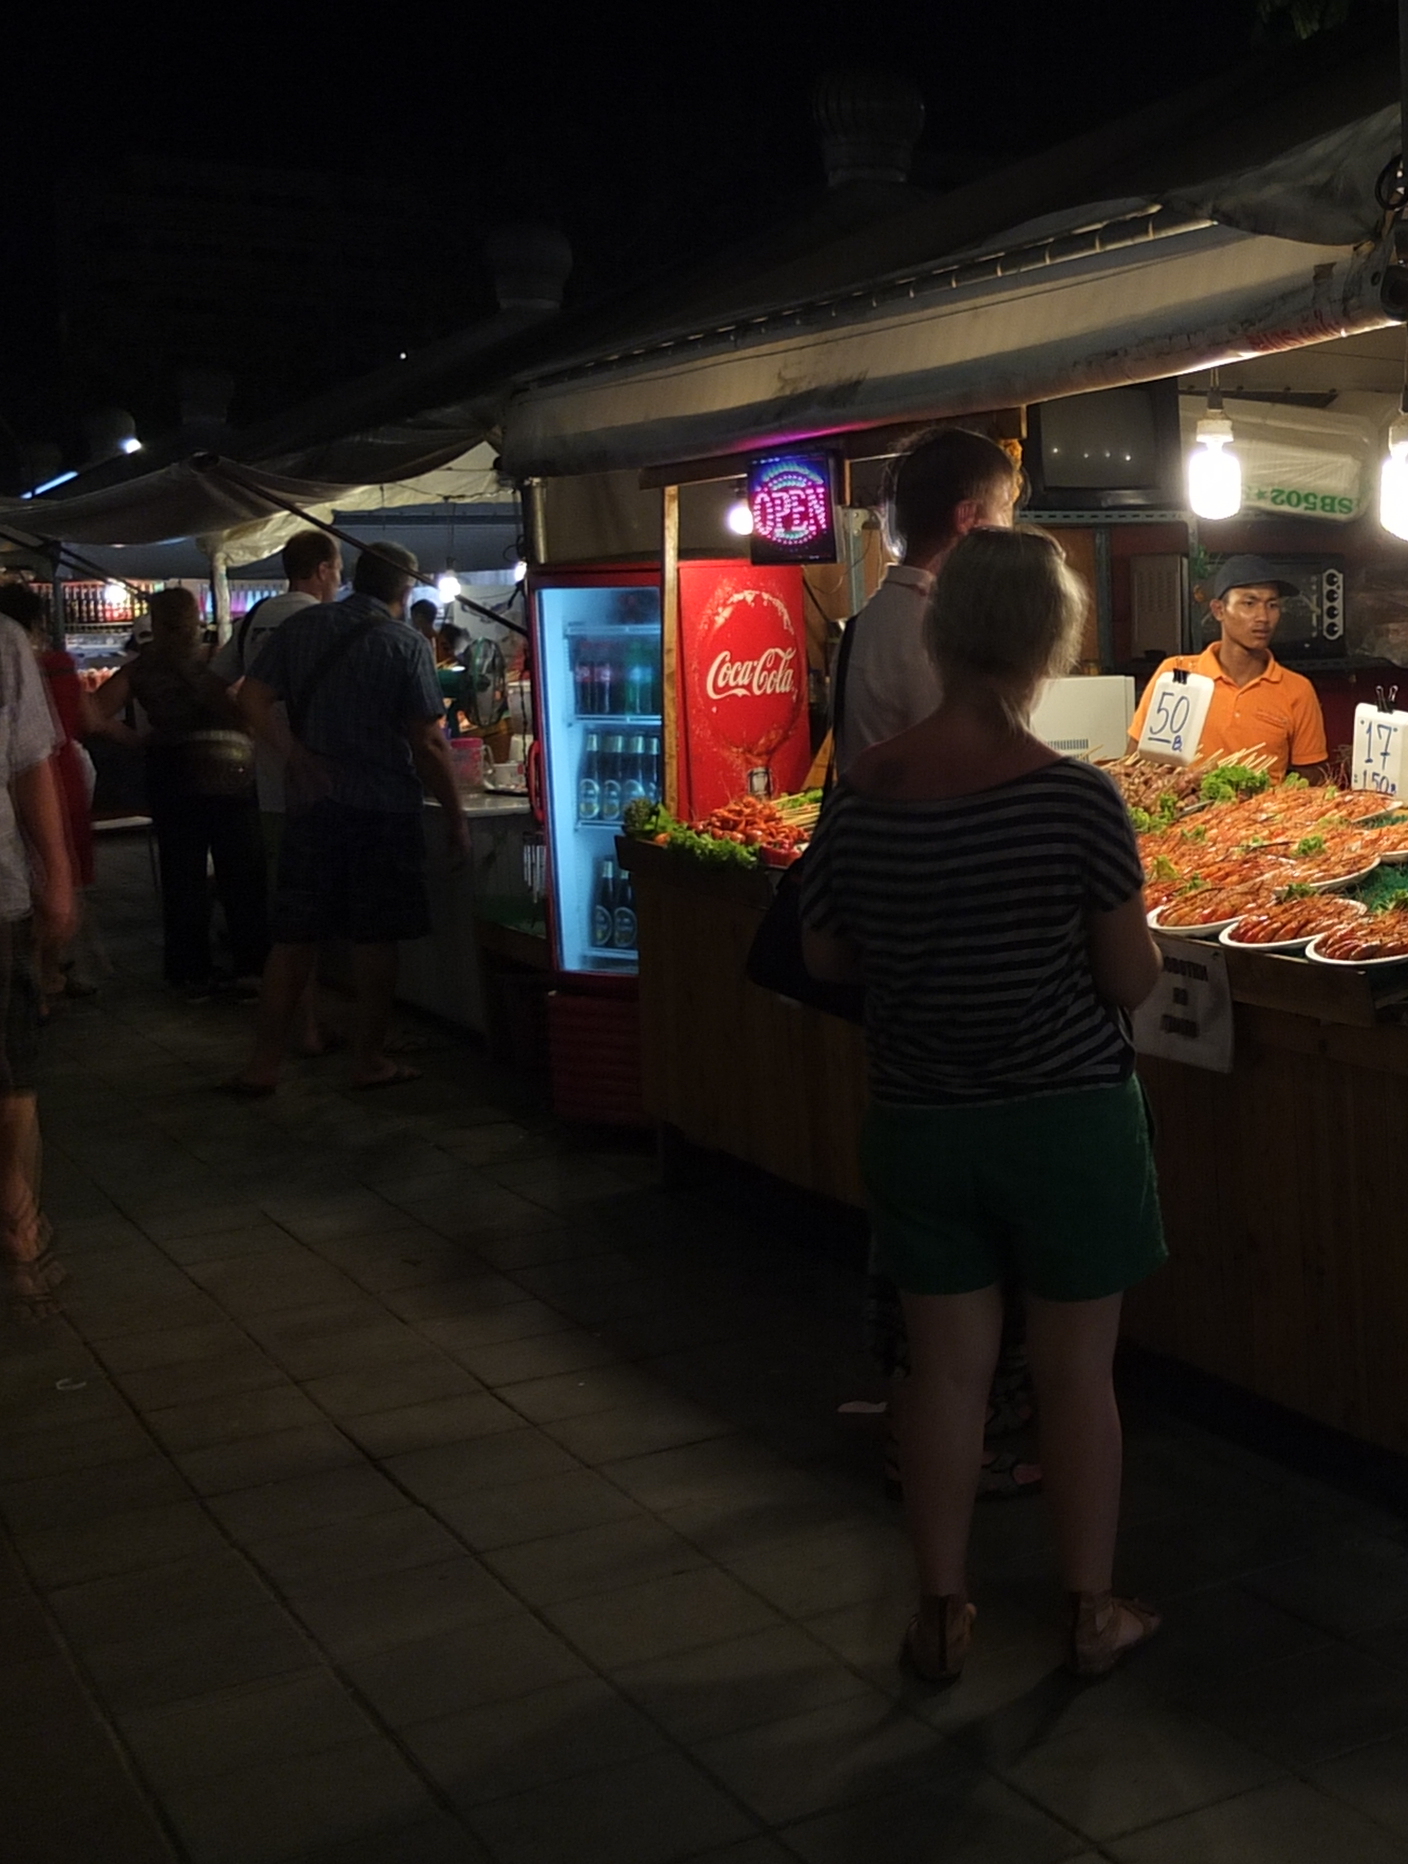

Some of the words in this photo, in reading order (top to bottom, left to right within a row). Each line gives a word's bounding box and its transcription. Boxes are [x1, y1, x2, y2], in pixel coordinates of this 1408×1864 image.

[753, 487, 826, 536] OPEN
[1270, 487, 1353, 515] SB502
[706, 646, 797, 700] Coca-Cola
[1149, 691, 1190, 735] 50
[1366, 720, 1393, 771] 17
